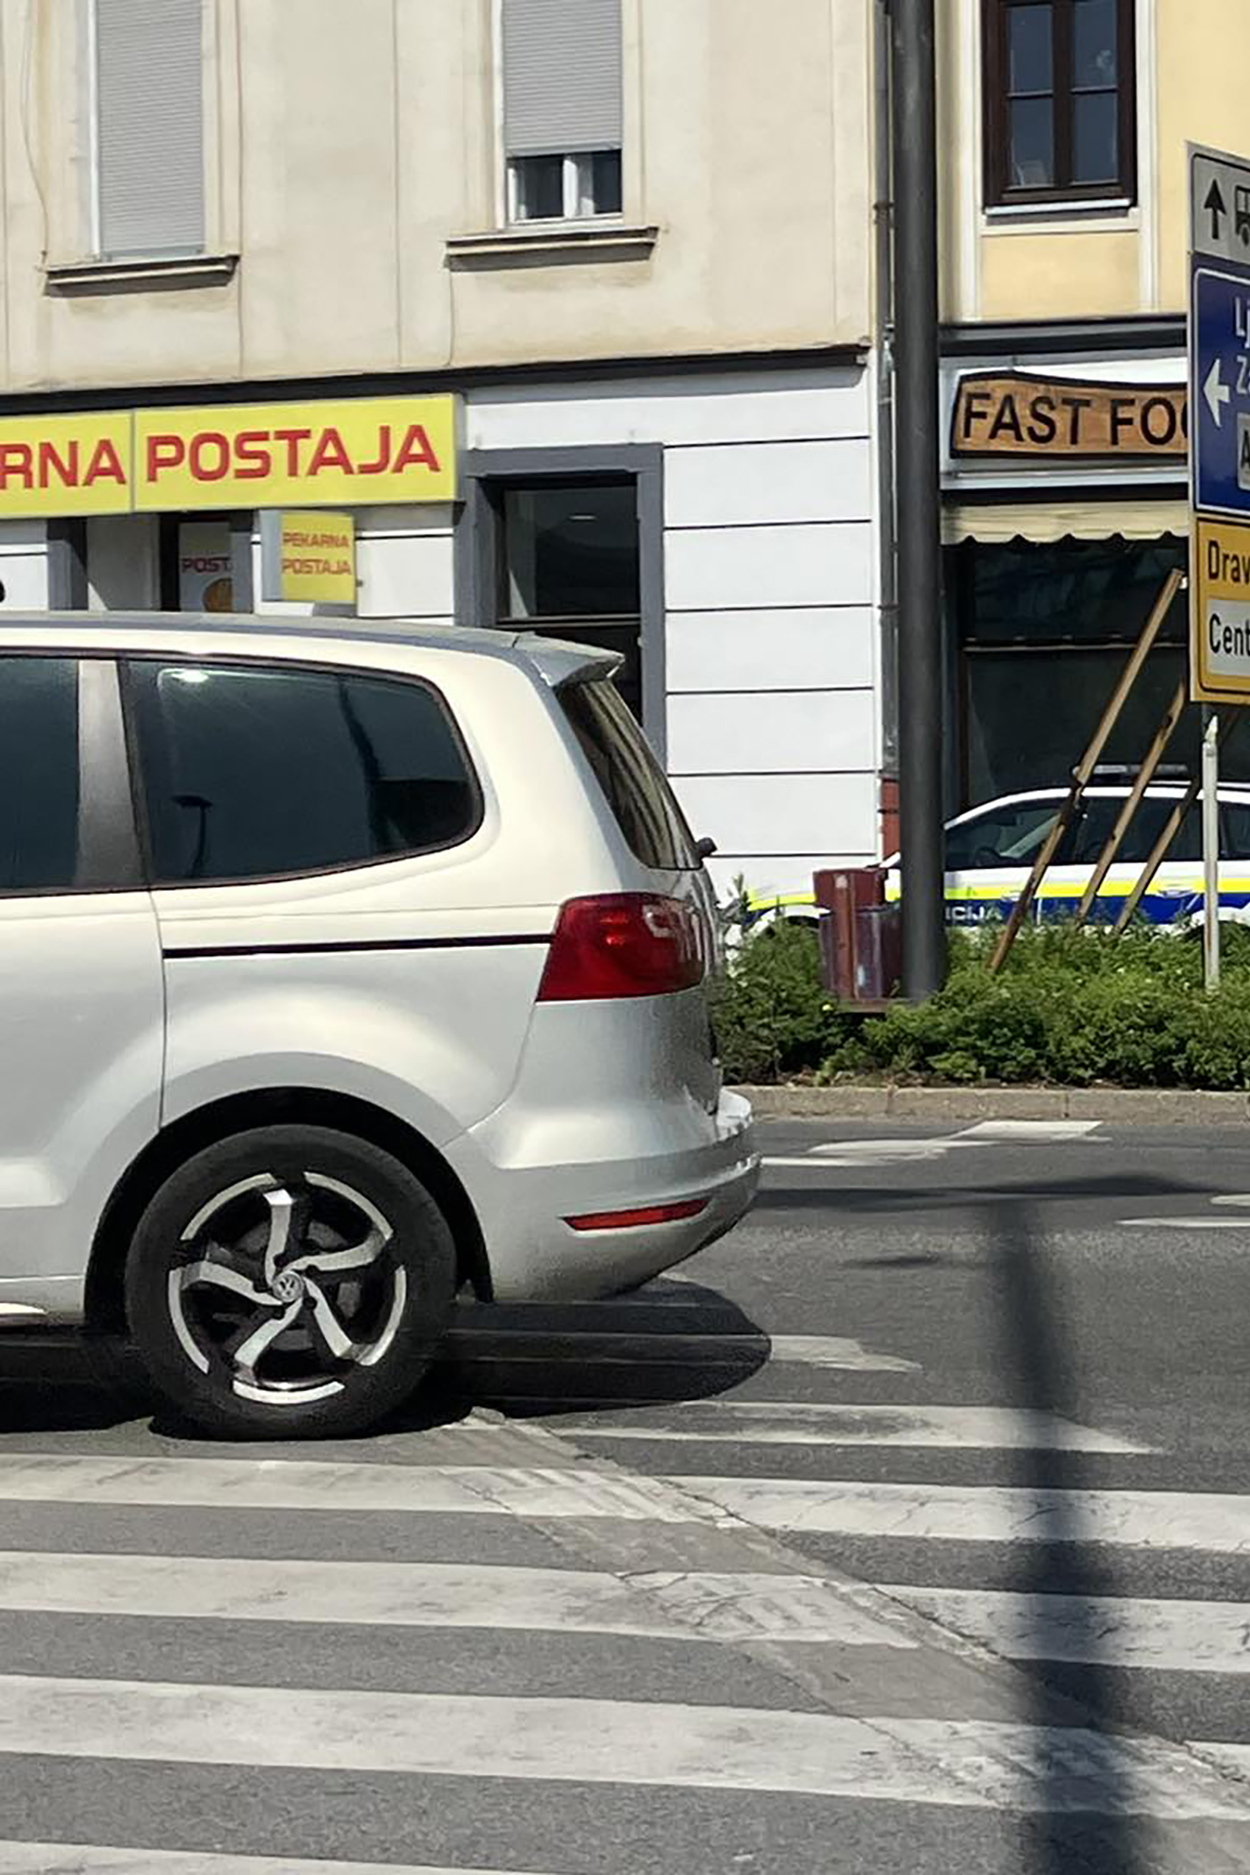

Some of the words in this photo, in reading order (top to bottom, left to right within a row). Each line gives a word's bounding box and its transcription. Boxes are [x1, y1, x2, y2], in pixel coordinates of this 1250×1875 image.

[963, 391, 1092, 446] FAST
[1110, 396, 1187, 446] FO
[146, 424, 441, 483] POSTAJA
[283, 532, 349, 548] PEKARNA
[281, 557, 352, 576] POSTAJA
